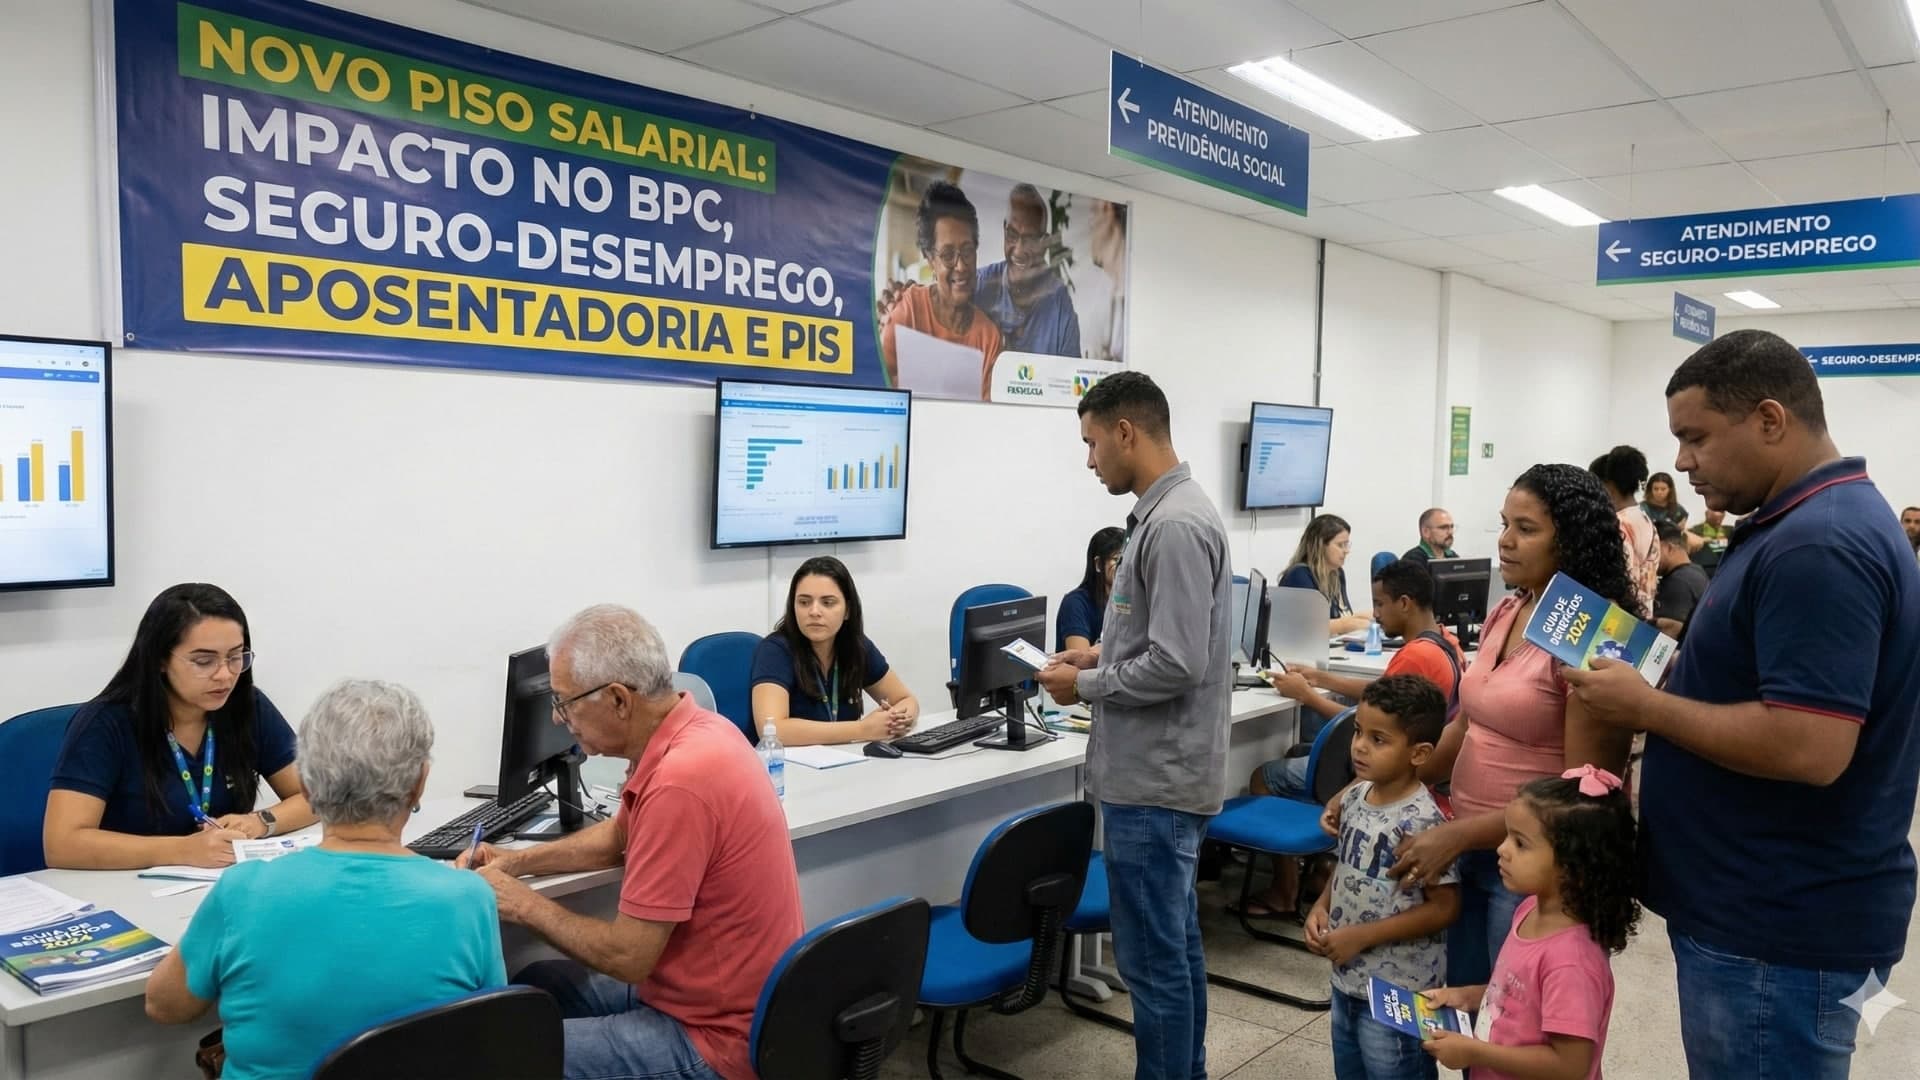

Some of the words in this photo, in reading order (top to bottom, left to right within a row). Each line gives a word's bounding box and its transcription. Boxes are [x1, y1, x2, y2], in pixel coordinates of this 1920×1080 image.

[199, 20, 391, 102] NOVO
[410, 70, 533, 131] PISO
[550, 103, 767, 183] SALARIAL:
[1173, 96, 1268, 150] ATENDIMENTO
[201, 94, 514, 197] IMPACTO
[533, 161, 613, 213] NO
[630, 175, 733, 243] BPC,
[1148, 118, 1240, 171] PREVIDÊNCIA
[1243, 154, 1286, 187] SOCIAL
[203, 175, 844, 316] SEGURO-DESEMPREGO,
[1640, 235, 1876, 267] SEGURO-DESEMPREGO
[1681, 215, 1831, 242] ATENDIMENTO
[203, 256, 733, 354] APOSENTADORIA
[747, 317, 767, 357] E
[781, 321, 840, 363] PIS
[1543, 611, 1561, 633] GUIA
[1554, 596, 1568, 611] DE
[1565, 611, 1592, 646] 2024
